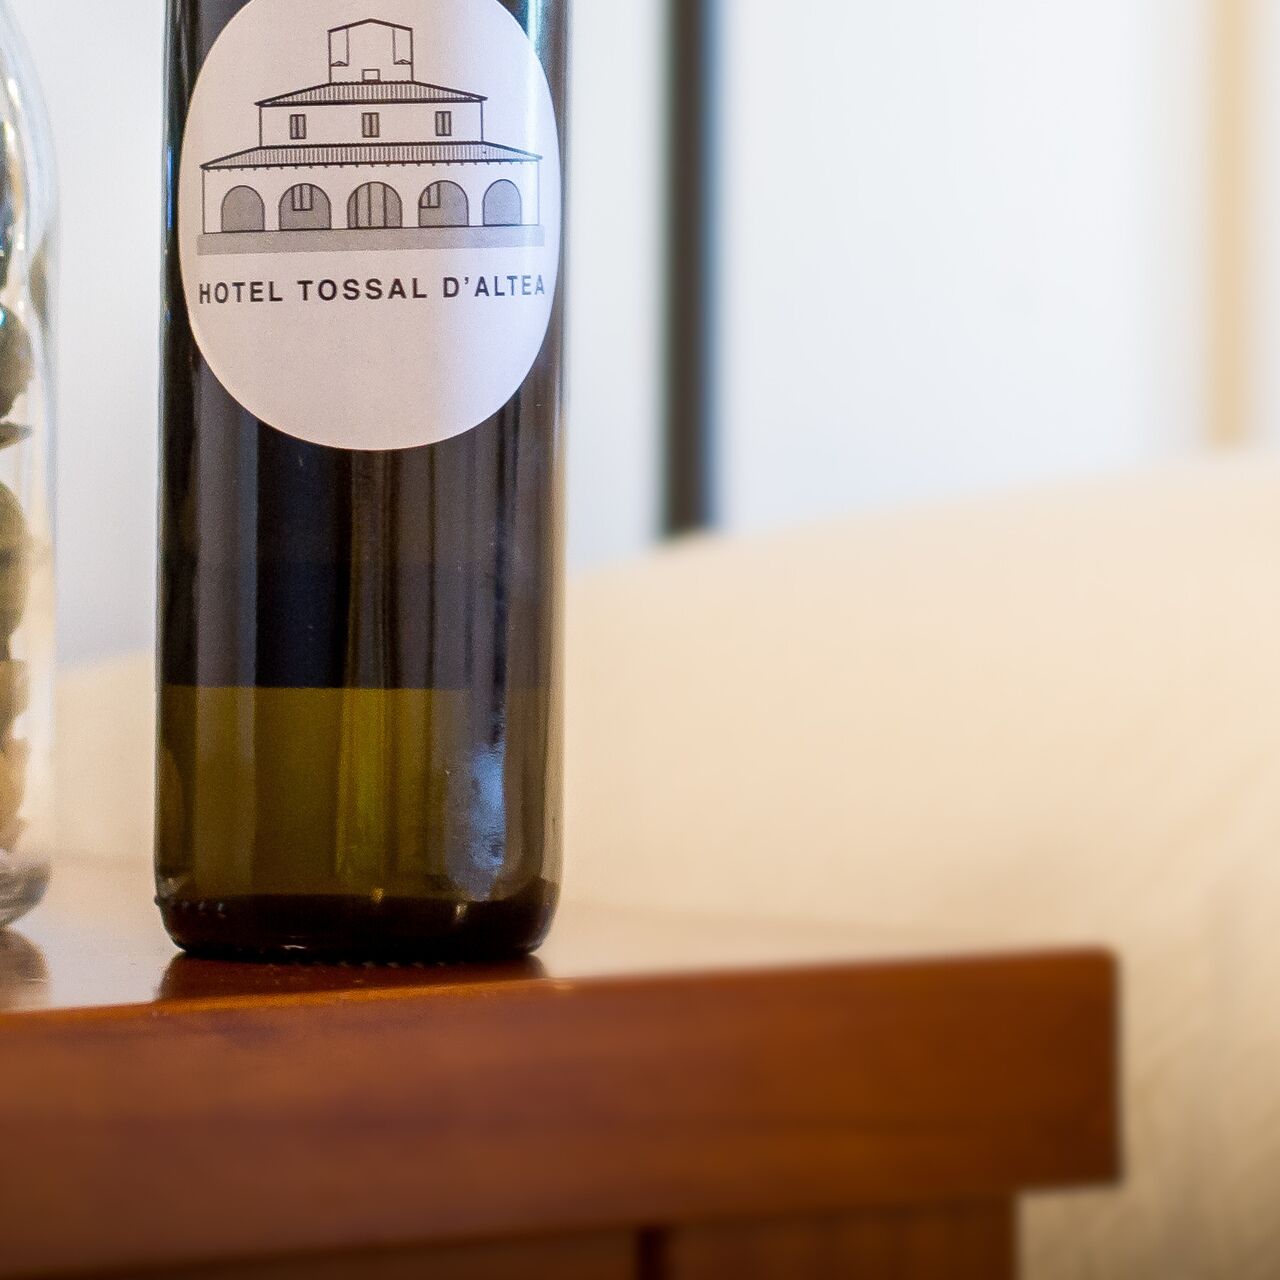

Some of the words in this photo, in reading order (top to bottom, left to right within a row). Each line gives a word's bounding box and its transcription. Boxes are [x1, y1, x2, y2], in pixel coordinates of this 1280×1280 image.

[199, 280, 283, 304] HOTEL
[297, 277, 428, 302] TOSSAL
[443, 275, 546, 299] D'ALTEA
